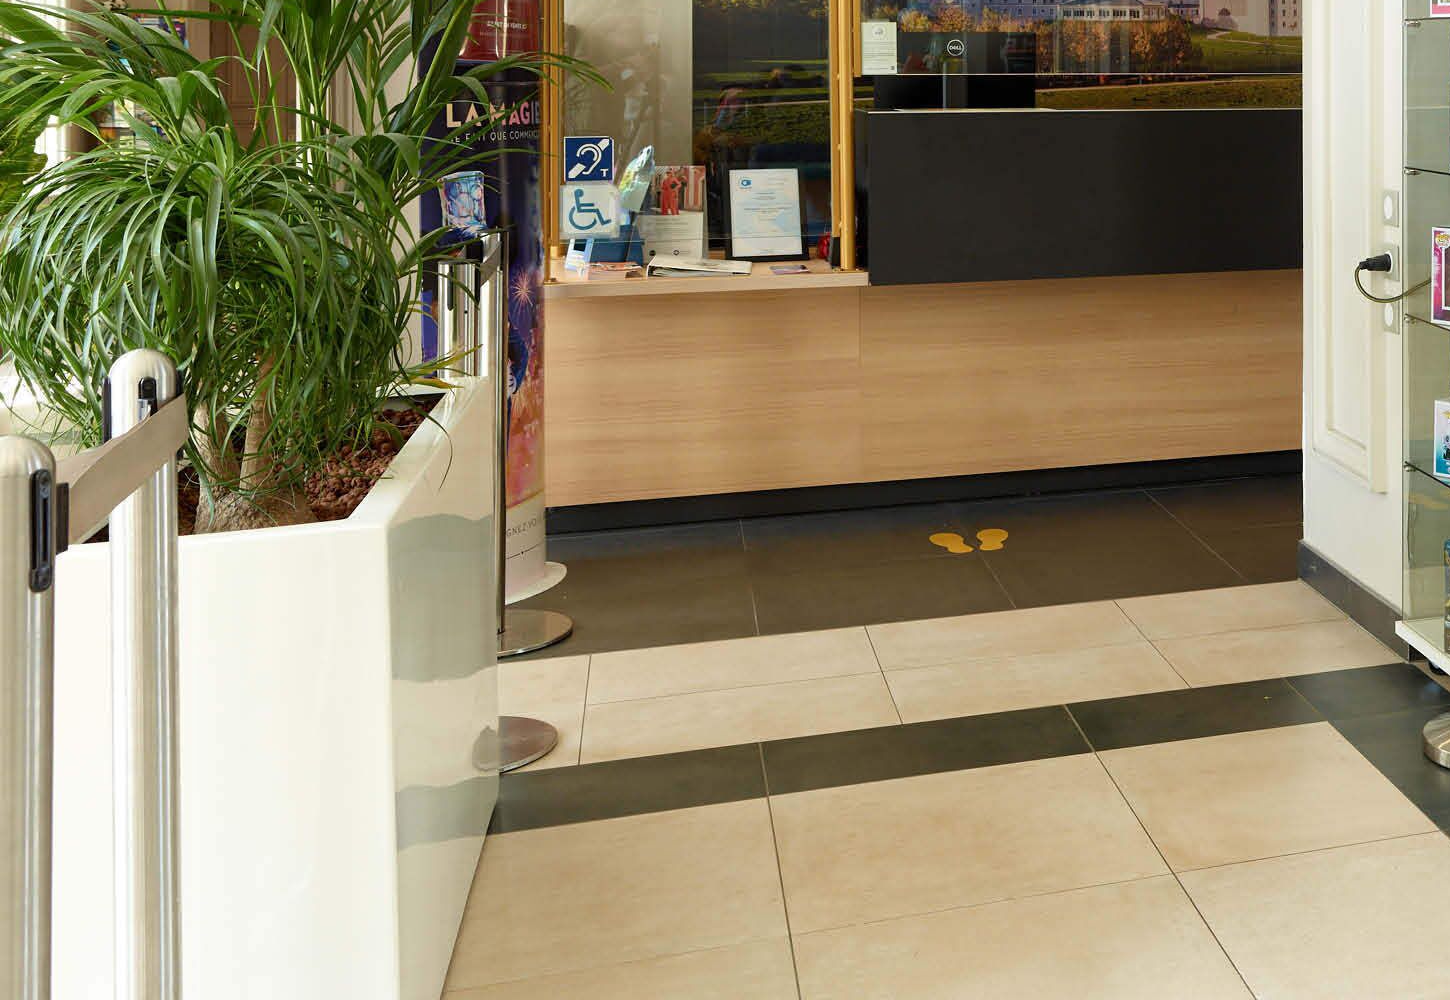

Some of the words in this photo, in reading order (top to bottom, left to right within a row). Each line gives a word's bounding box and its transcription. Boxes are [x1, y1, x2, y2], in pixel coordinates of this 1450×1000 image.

[446, 102, 482, 128] LA
[490, 131, 507, 141] QUE
[600, 168, 608, 178] T
